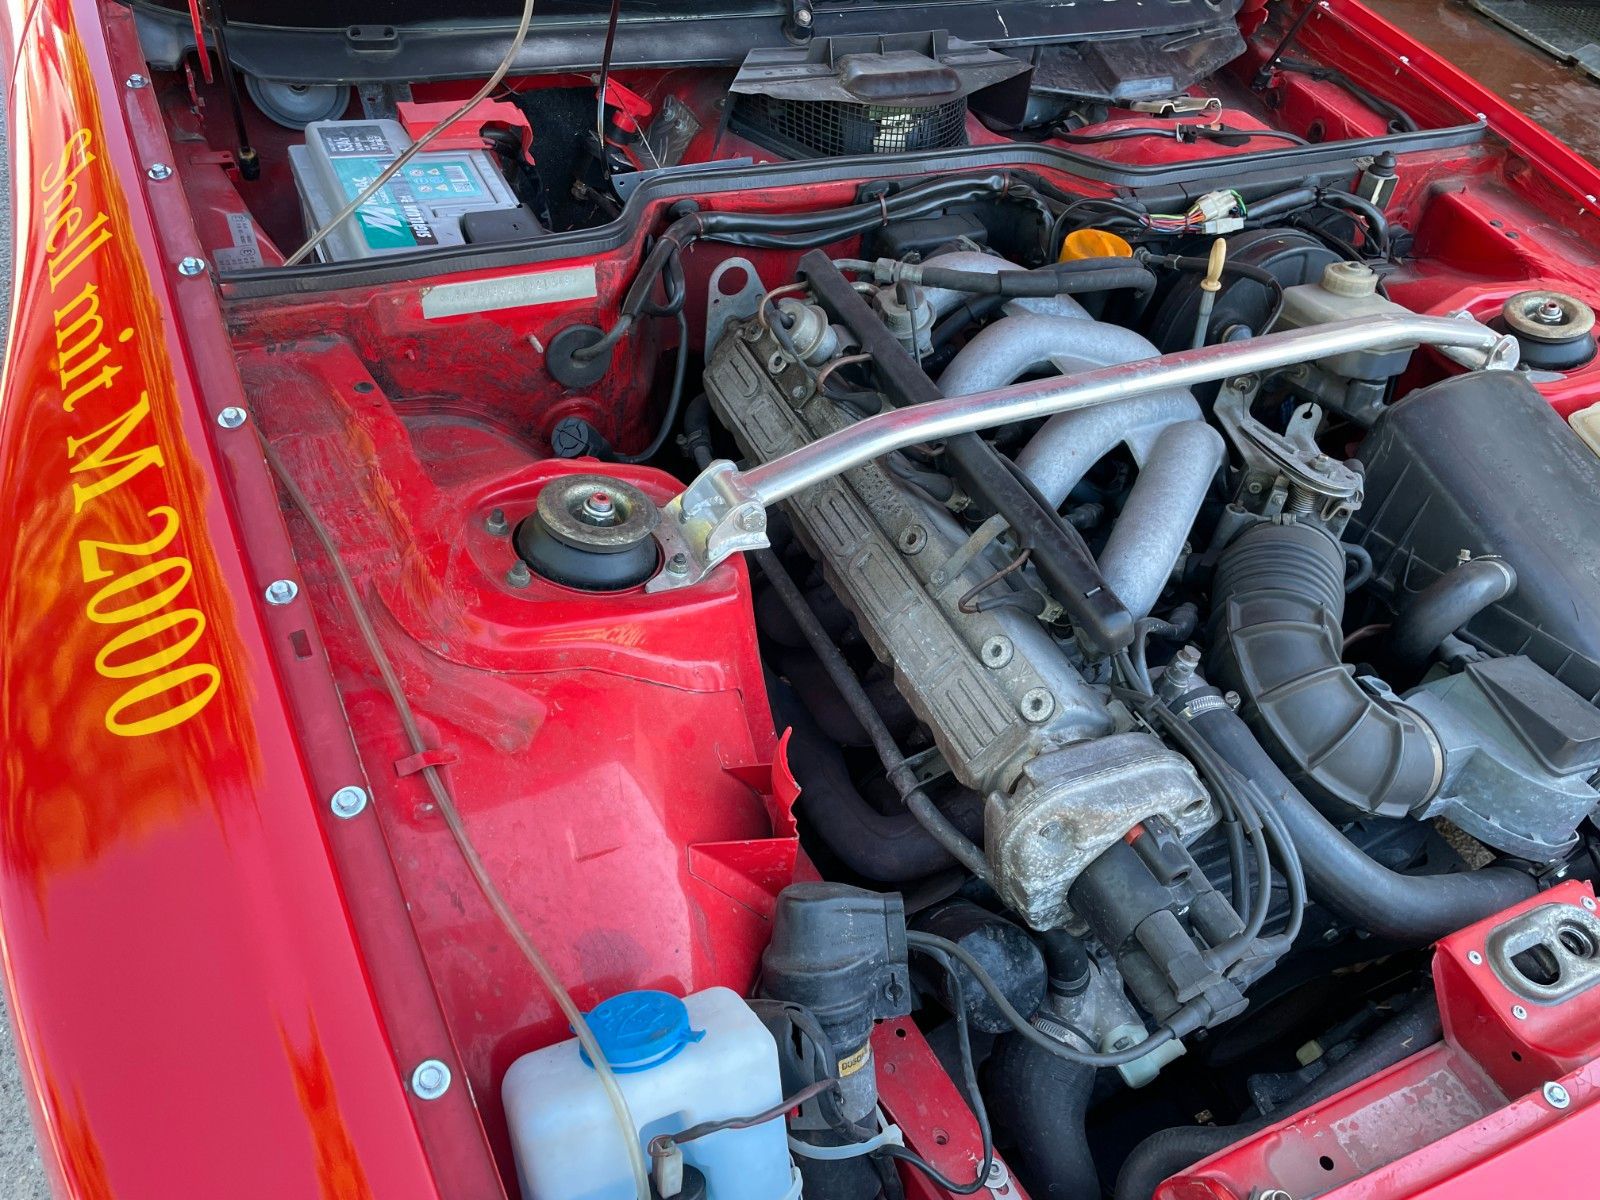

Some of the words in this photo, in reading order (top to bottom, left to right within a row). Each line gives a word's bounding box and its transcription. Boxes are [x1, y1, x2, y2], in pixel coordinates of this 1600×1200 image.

[40, 127, 113, 293] Shell
[54, 284, 134, 413] mit
[67, 390, 166, 515] M
[79, 506, 221, 737] 2000
